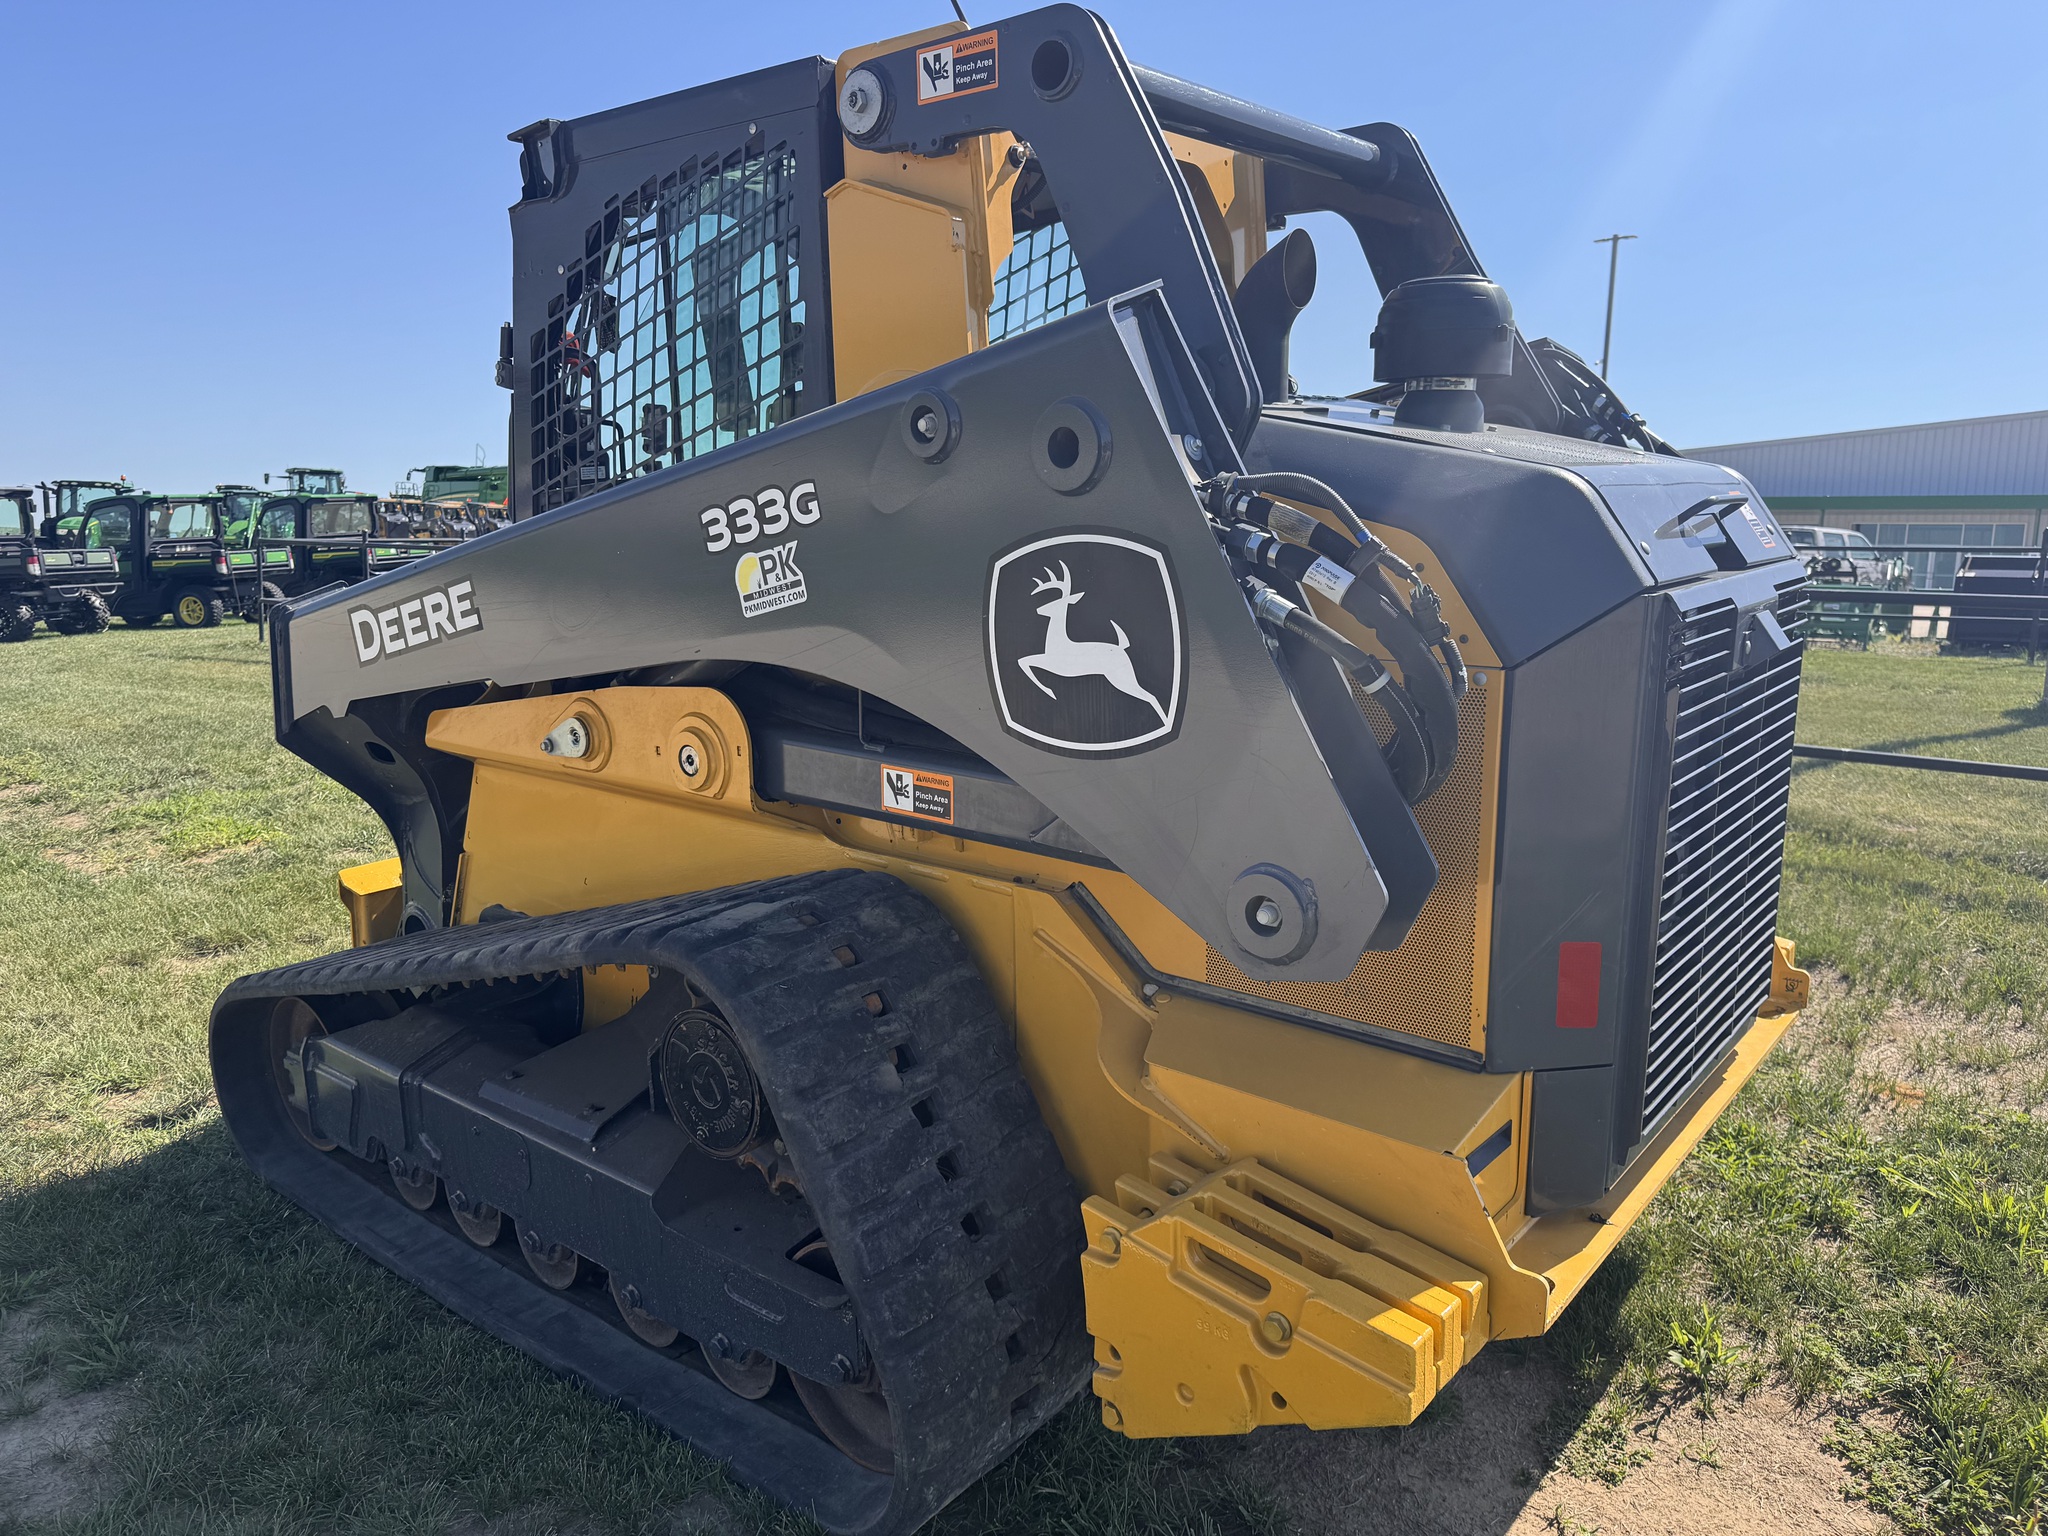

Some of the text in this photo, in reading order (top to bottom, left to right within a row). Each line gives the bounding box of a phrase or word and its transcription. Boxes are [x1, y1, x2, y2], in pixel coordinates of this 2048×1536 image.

[962, 37, 993, 50] WARNING
[955, 58, 993, 73] Pinch Area
[955, 72, 988, 84] Keep Away
[700, 482, 821, 552] 333G
[752, 581, 793, 599] MIDWEST
[744, 589, 806, 615] PKMIDWEST.COM
[350, 580, 480, 663] DEERE
[921, 775, 949, 787] WARNING
[915, 790, 949, 804] Pinch Area
[915, 801, 944, 813] Keep Away
